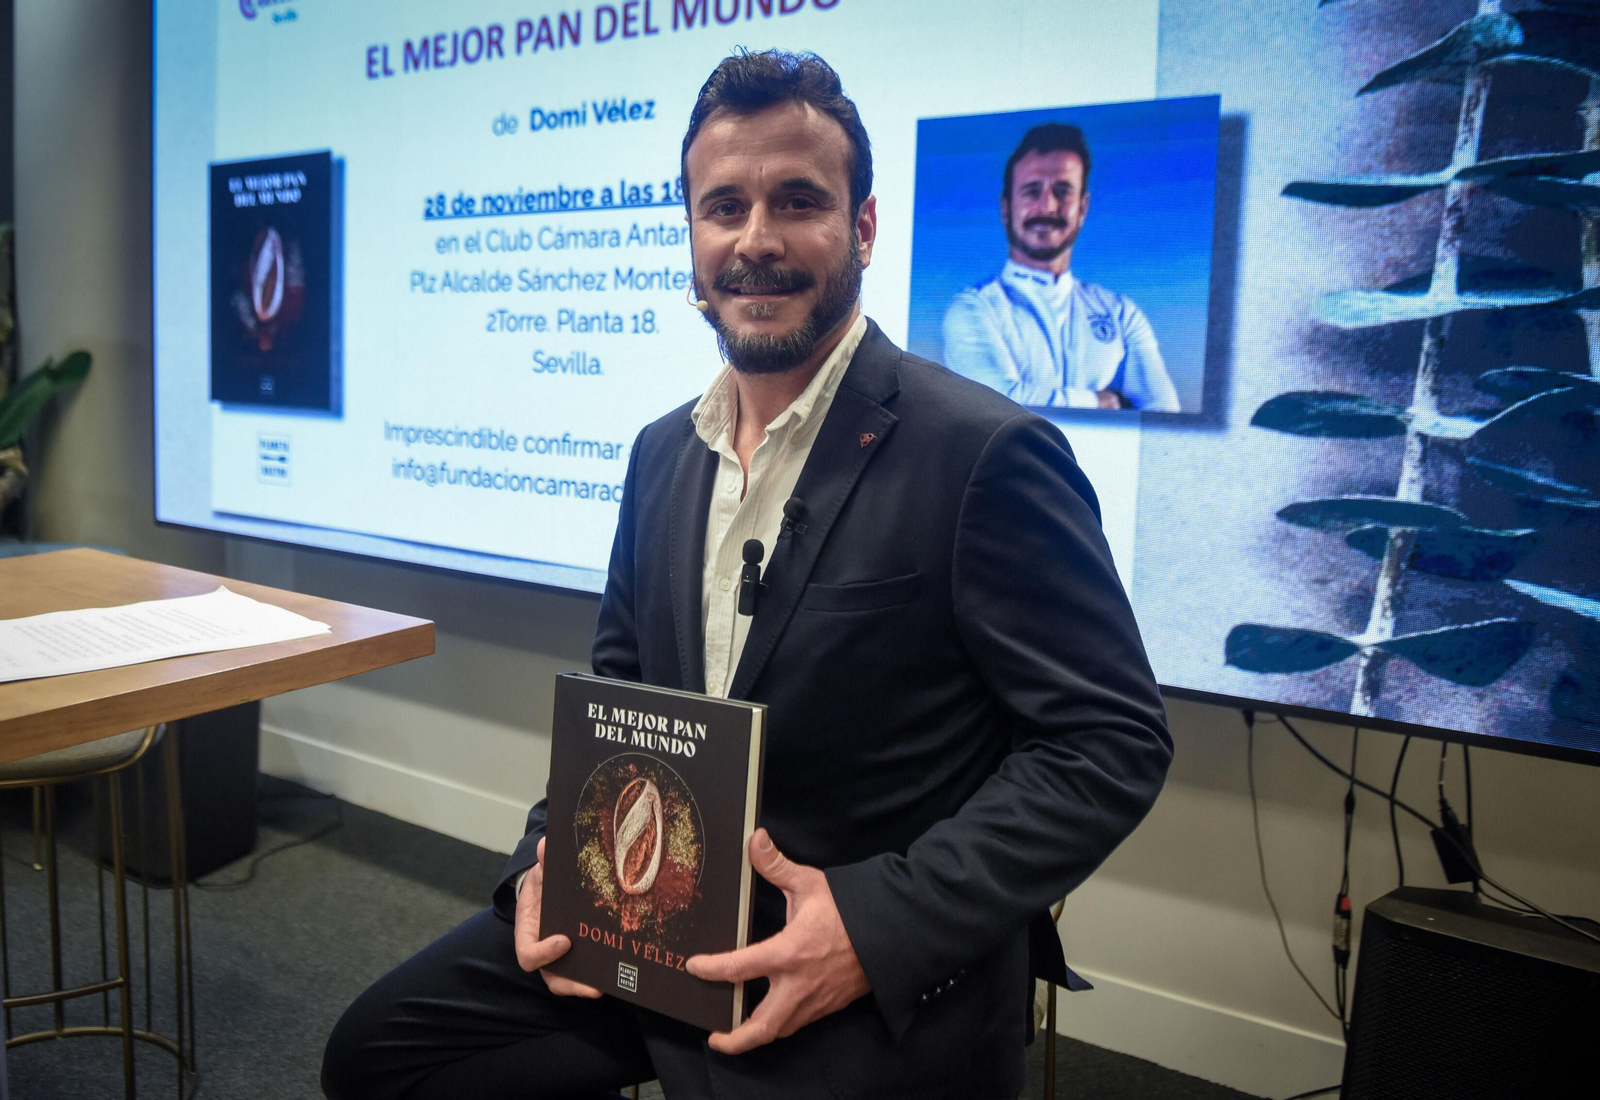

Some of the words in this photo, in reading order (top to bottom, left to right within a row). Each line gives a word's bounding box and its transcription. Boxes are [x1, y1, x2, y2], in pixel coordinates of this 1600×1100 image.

[366, 45, 394, 80] EL
[403, 24, 504, 74] MEJOR
[515, 10, 582, 55] PAN
[594, 0, 659, 43] DEL
[672, 0, 841, 31] MUN
[492, 112, 518, 136] de
[530, 99, 587, 132] Domi
[593, 97, 655, 125] Vélez
[424, 192, 445, 217] 28
[452, 191, 475, 215] de
[481, 184, 594, 214] noviembre
[601, 186, 614, 207] a
[620, 180, 653, 205] las
[435, 235, 459, 254] en
[464, 230, 481, 253] el
[485, 227, 533, 252] Club
[537, 225, 621, 251] Cámara
[410, 269, 436, 294] Plz
[440, 268, 512, 293] Alcalde
[517, 266, 607, 292] Sánchez
[485, 308, 550, 333] 2Torre.
[556, 309, 624, 334] Planta
[630, 310, 659, 334] 18.
[532, 350, 604, 376] Sevilla.
[384, 420, 518, 451] Imprescindible
[523, 432, 624, 460] confirmar
[587, 703, 608, 721] EL
[611, 707, 669, 734] MEJOR
[673, 718, 707, 741] PAN
[594, 722, 627, 744] DEL
[630, 730, 697, 758] MUNDO
[578, 922, 624, 950] DOMI
[631, 939, 686, 972] VÉLEZ
